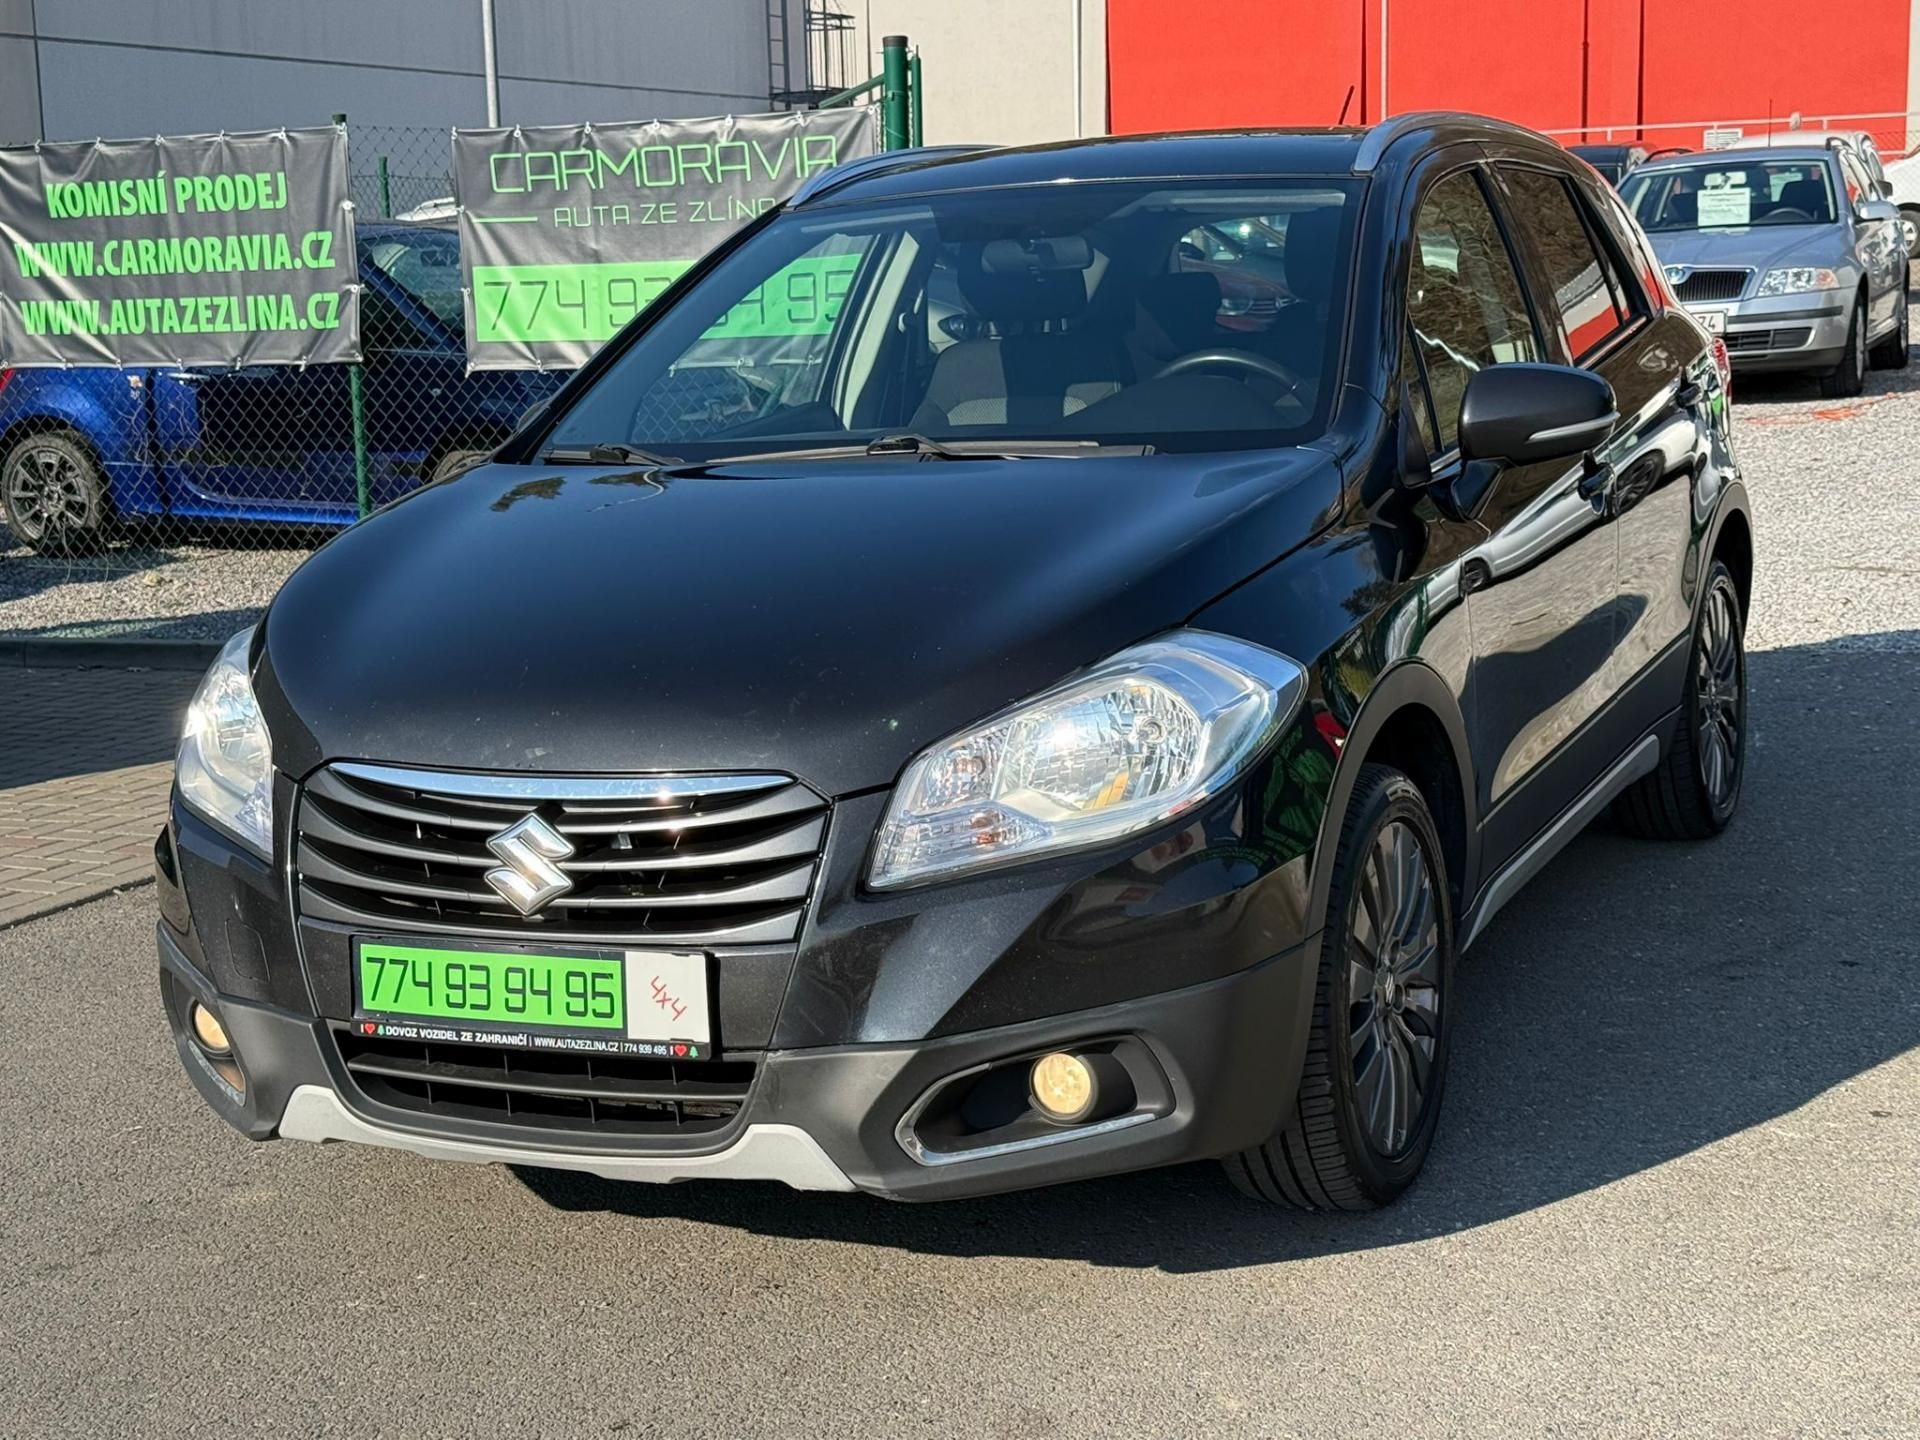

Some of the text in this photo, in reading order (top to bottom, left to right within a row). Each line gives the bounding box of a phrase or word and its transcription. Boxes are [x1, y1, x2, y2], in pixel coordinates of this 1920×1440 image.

[490, 135, 837, 192] CARMORAVIA
[46, 171, 287, 218] KOMISNÍ PRODEJ
[553, 203, 631, 229] AUTA
[640, 201, 679, 226] ZE
[15, 231, 335, 277] WWW.CARMORAVIA.CZ
[21, 292, 340, 335] WWW.AUTAZEZLINA.CZ
[482, 279, 588, 331] 774
[366, 957, 614, 1018] 774 93 94 95
[385, 1026, 418, 1038] DOVOZ
[420, 1028, 459, 1041] VOZIDEL
[460, 1031, 474, 1042] ZE
[475, 1032, 528, 1046] ZAHRANIČÍ
[534, 1037, 619, 1052] WWW.AUTAZEZLINA.CZ
[624, 1044, 637, 1054] 774
